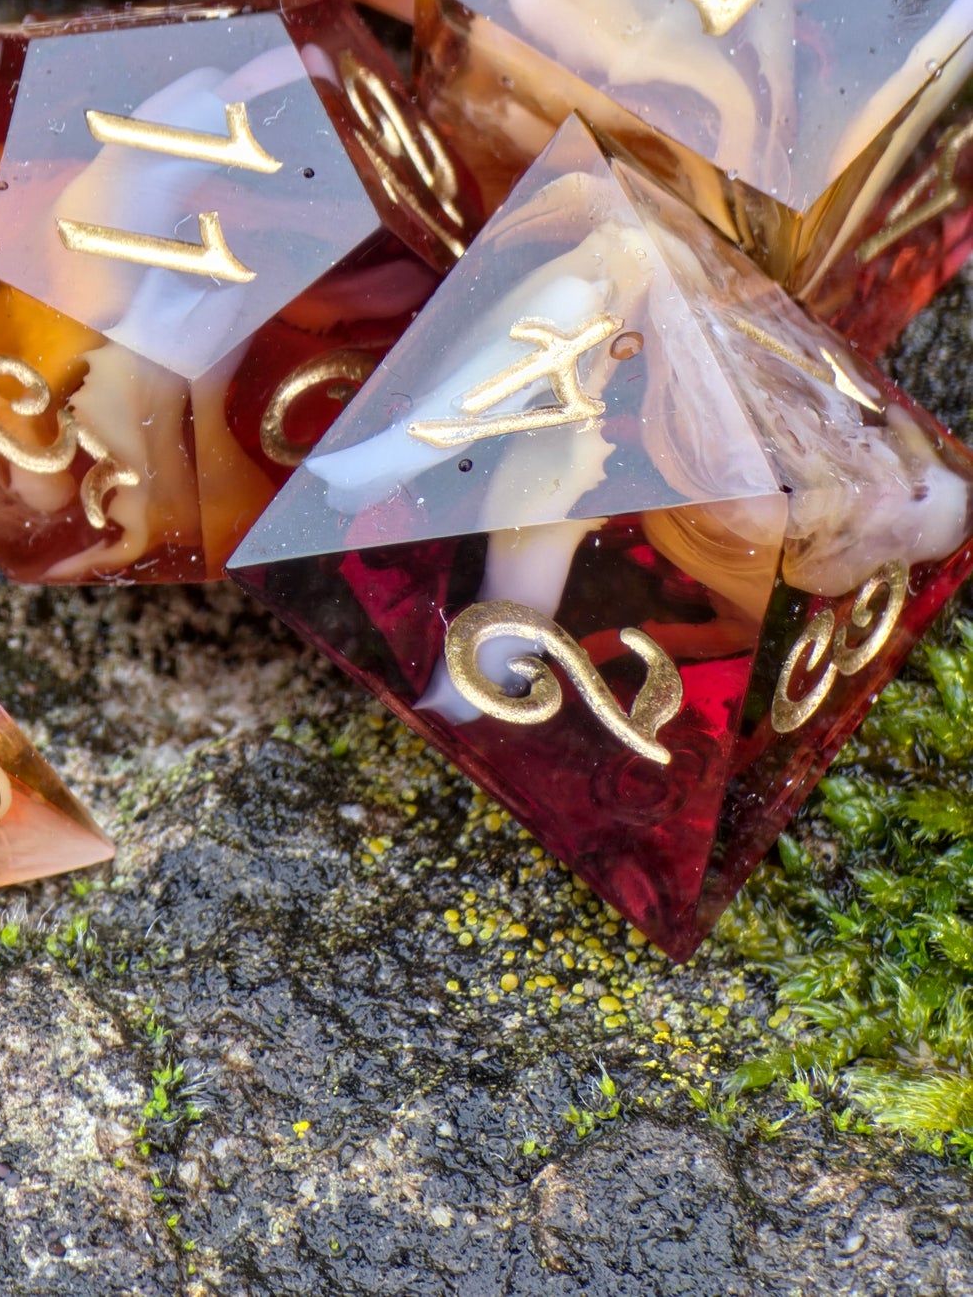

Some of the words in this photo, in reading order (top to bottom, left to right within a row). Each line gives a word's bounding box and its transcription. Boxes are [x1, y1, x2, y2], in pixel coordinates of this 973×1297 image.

[55, 101, 284, 284] 11
[406, 312, 625, 449] 4
[443, 598, 685, 765] 2
